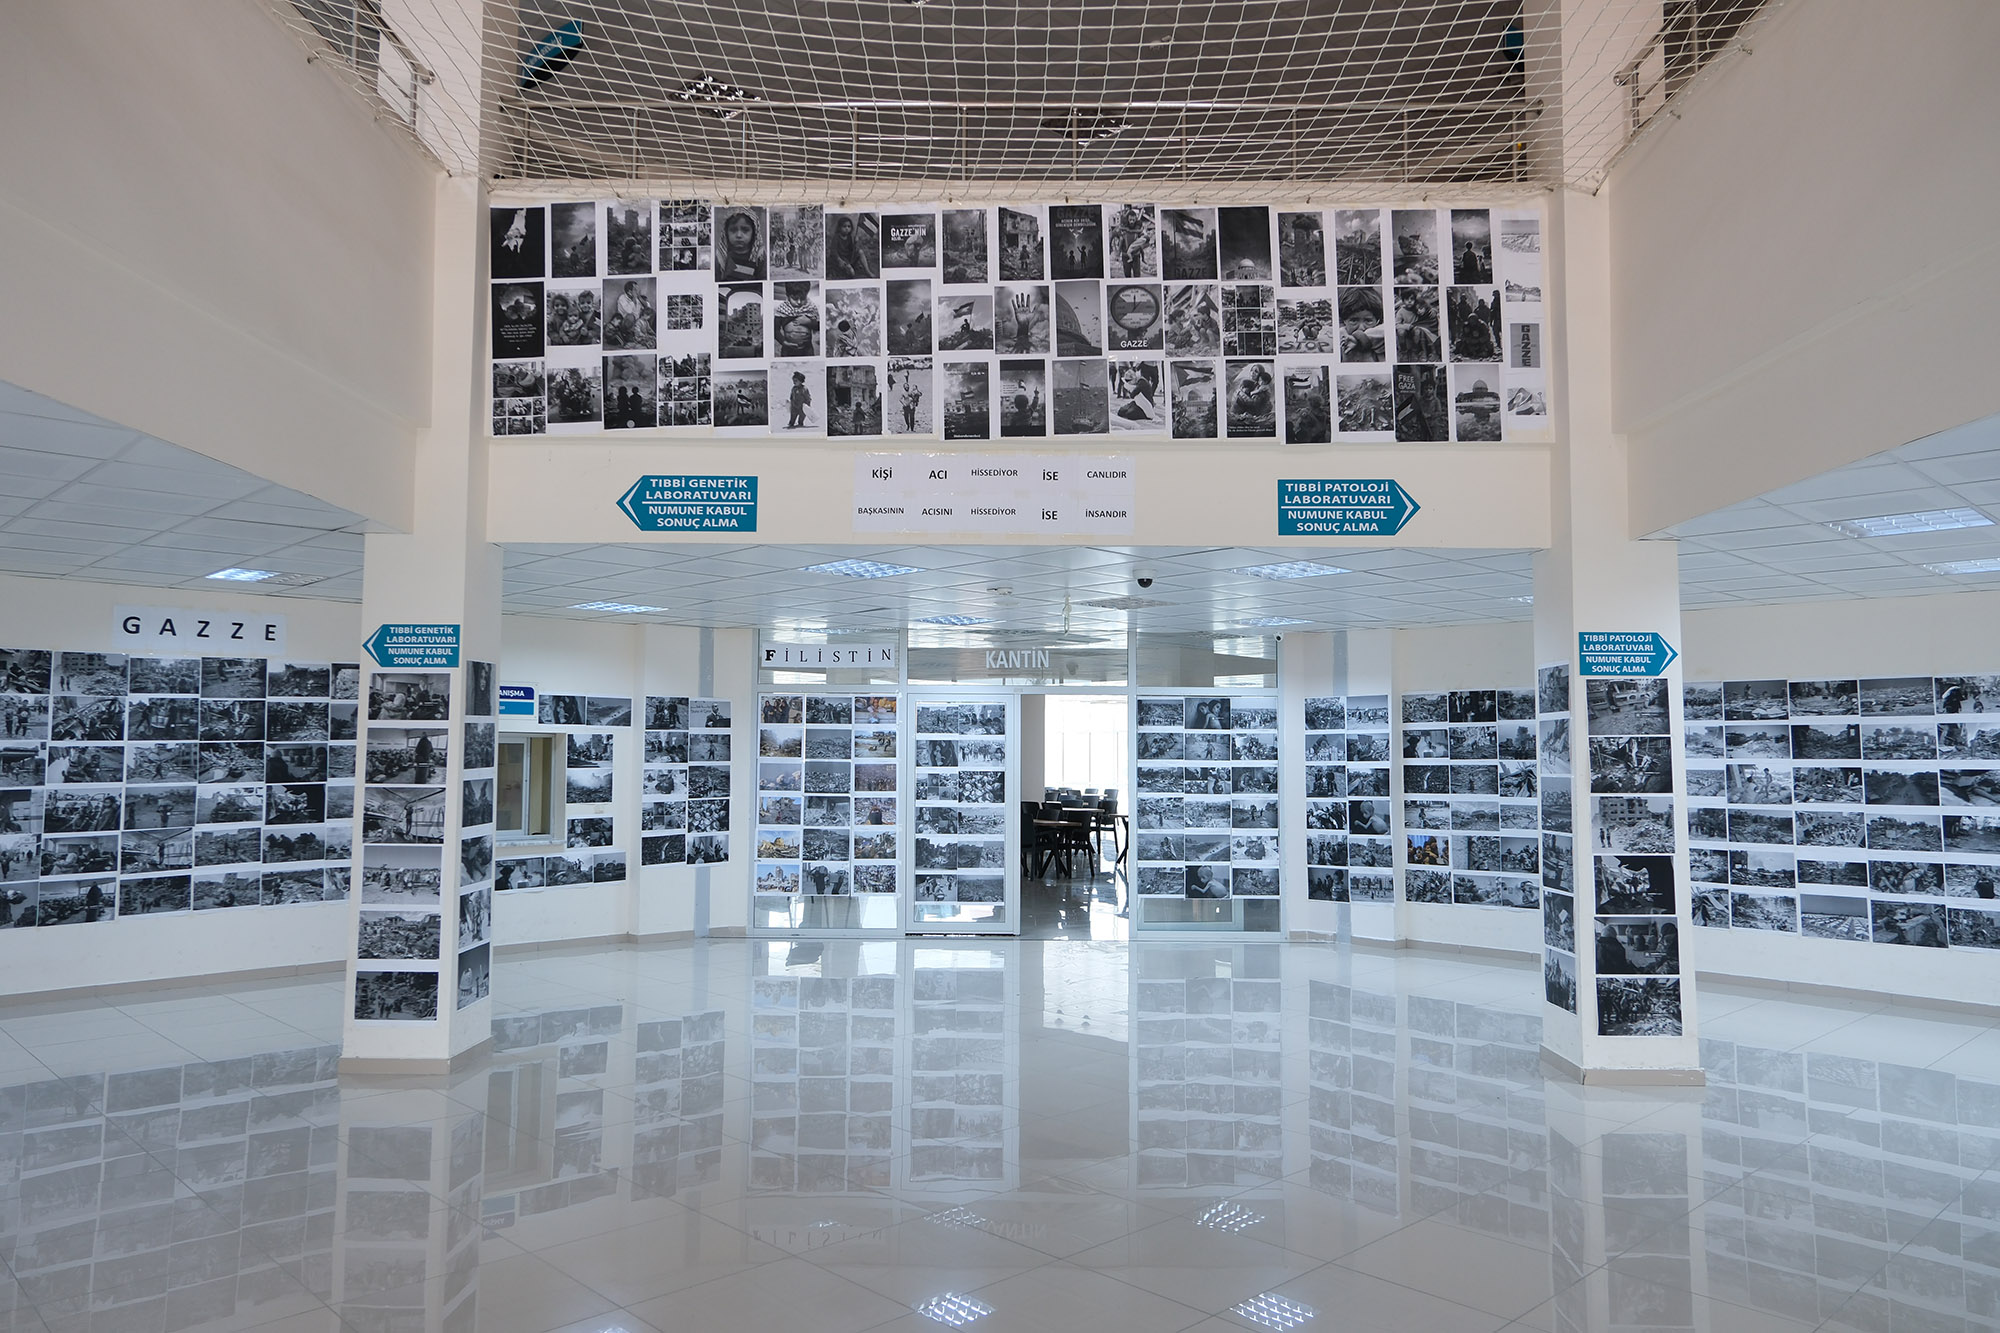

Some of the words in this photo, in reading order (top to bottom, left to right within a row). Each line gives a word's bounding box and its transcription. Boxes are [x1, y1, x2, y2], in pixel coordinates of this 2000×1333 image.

[1120, 340, 1149, 348] GAZZE
[1279, 341, 1330, 352] STOP
[1398, 374, 1415, 383] FREE
[1398, 382, 1416, 390] GAZA
[872, 466, 893, 480] KİŞİ
[928, 470, 948, 480] ACI
[971, 468, 1018, 477] HİSSEDİYOR
[1042, 469, 1059, 481] İSE
[1086, 471, 1127, 479] CANLIDIR
[650, 477, 685, 488] TIBBİ
[689, 478, 748, 488] GENETİK
[1285, 482, 1321, 492] TIBBİ
[1324, 482, 1389, 492] PATOLOJİ
[645, 491, 752, 500] LABORATUVARI
[1284, 495, 1391, 504] LABORATUVARI
[648, 506, 704, 515] NUMUNE
[706, 506, 747, 516] KABUL
[857, 507, 905, 516] BAŞKASININ
[921, 508, 953, 516] ACISINI
[970, 507, 1017, 516] HİSSEDİYOR
[1041, 508, 1058, 520] İSE
[1085, 508, 1127, 518] İNSANDIR
[1287, 510, 1343, 520] NUMUNE
[1345, 510, 1388, 520] KABUL
[657, 518, 700, 529] SONUÇ
[702, 519, 739, 528] ALMA
[1296, 522, 1340, 534] SONUÇ
[1342, 523, 1379, 532] ALMA
[122, 616, 277, 641] GAZZE
[389, 626, 413, 634] TIBBİ
[414, 626, 454, 634] GENETİK
[1583, 634, 1608, 642] TIBBİ
[1609, 634, 1652, 642] PATOLOJİ
[425, 648, 453, 656] KABUL
[765, 647, 892, 663] FİLİSTİN
[393, 657, 422, 666] SONUÇ
[985, 646, 1049, 669] KANTİN
[1623, 656, 1652, 664] KABUL
[1591, 665, 1621, 674] SONUÇ
